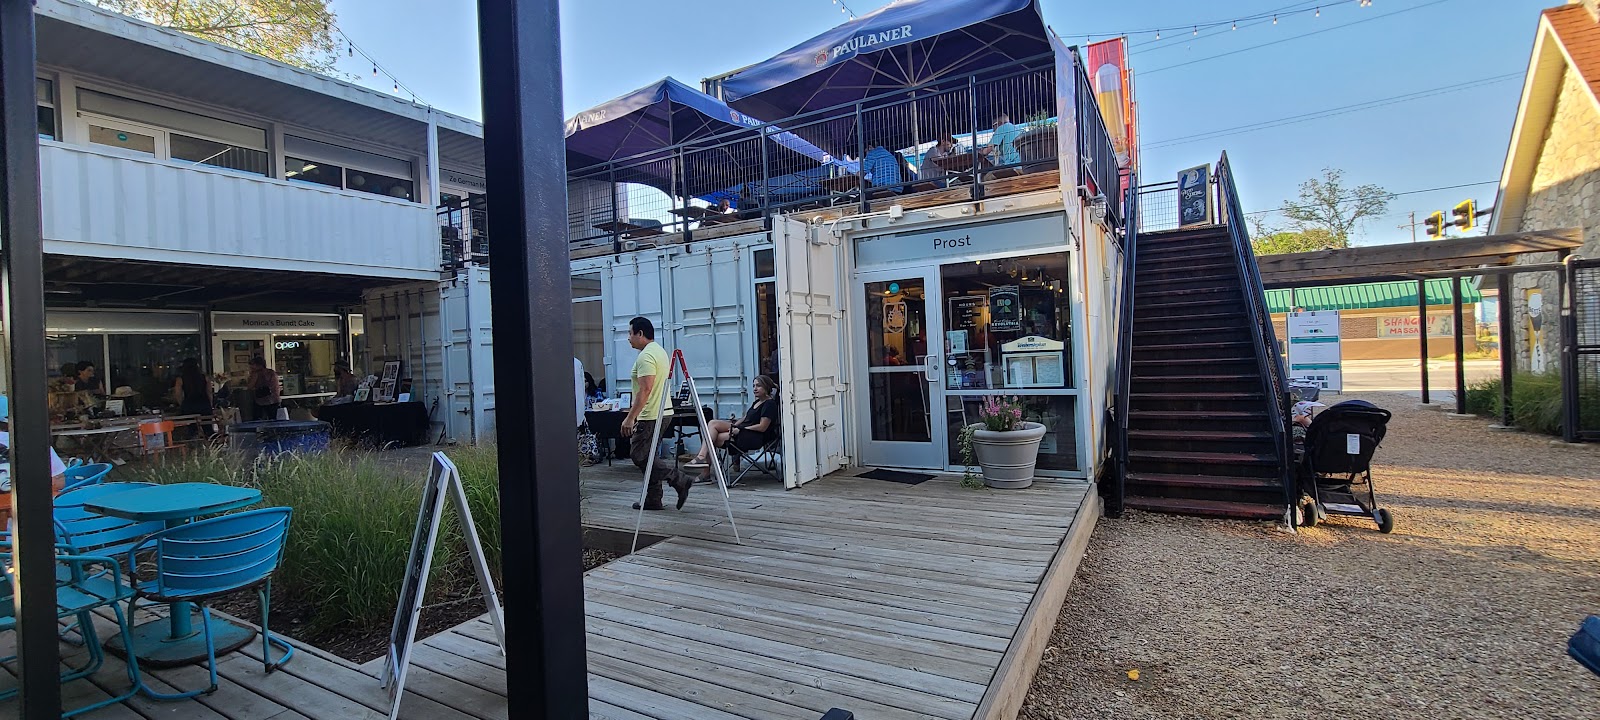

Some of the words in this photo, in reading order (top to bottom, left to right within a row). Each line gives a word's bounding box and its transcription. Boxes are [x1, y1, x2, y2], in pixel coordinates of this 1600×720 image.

[833, 25, 913, 58] PAULANER
[933, 234, 972, 250] Prost
[242, 319, 275, 327] Monica's
[276, 319, 298, 327] Bundt
[1383, 315, 1436, 327] SHANGI
[1389, 326, 1432, 334] MASSAE
[275, 341, 300, 350] open
